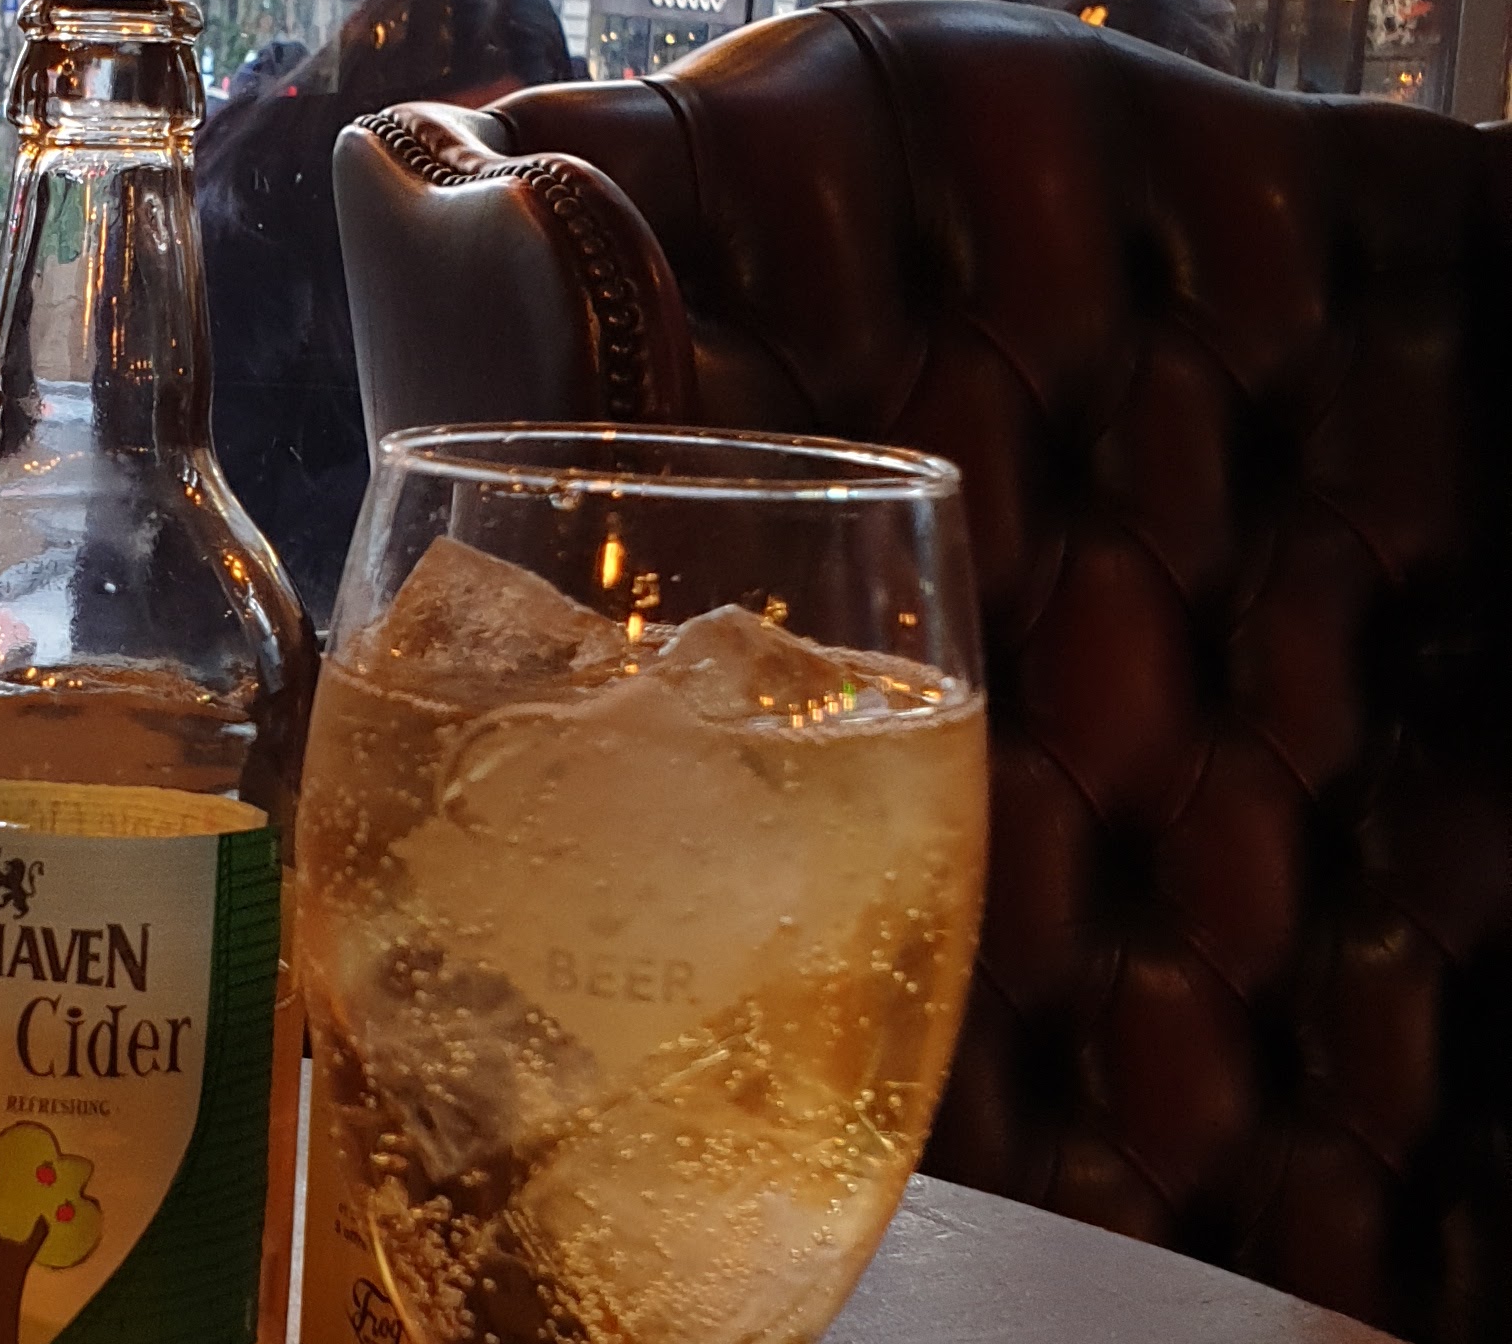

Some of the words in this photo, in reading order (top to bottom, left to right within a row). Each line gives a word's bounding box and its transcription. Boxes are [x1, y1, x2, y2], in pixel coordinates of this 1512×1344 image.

[544, 946, 697, 1004] BEER
[16, 993, 193, 1080] Cider
[5, 1093, 112, 1118] REFRESHING
